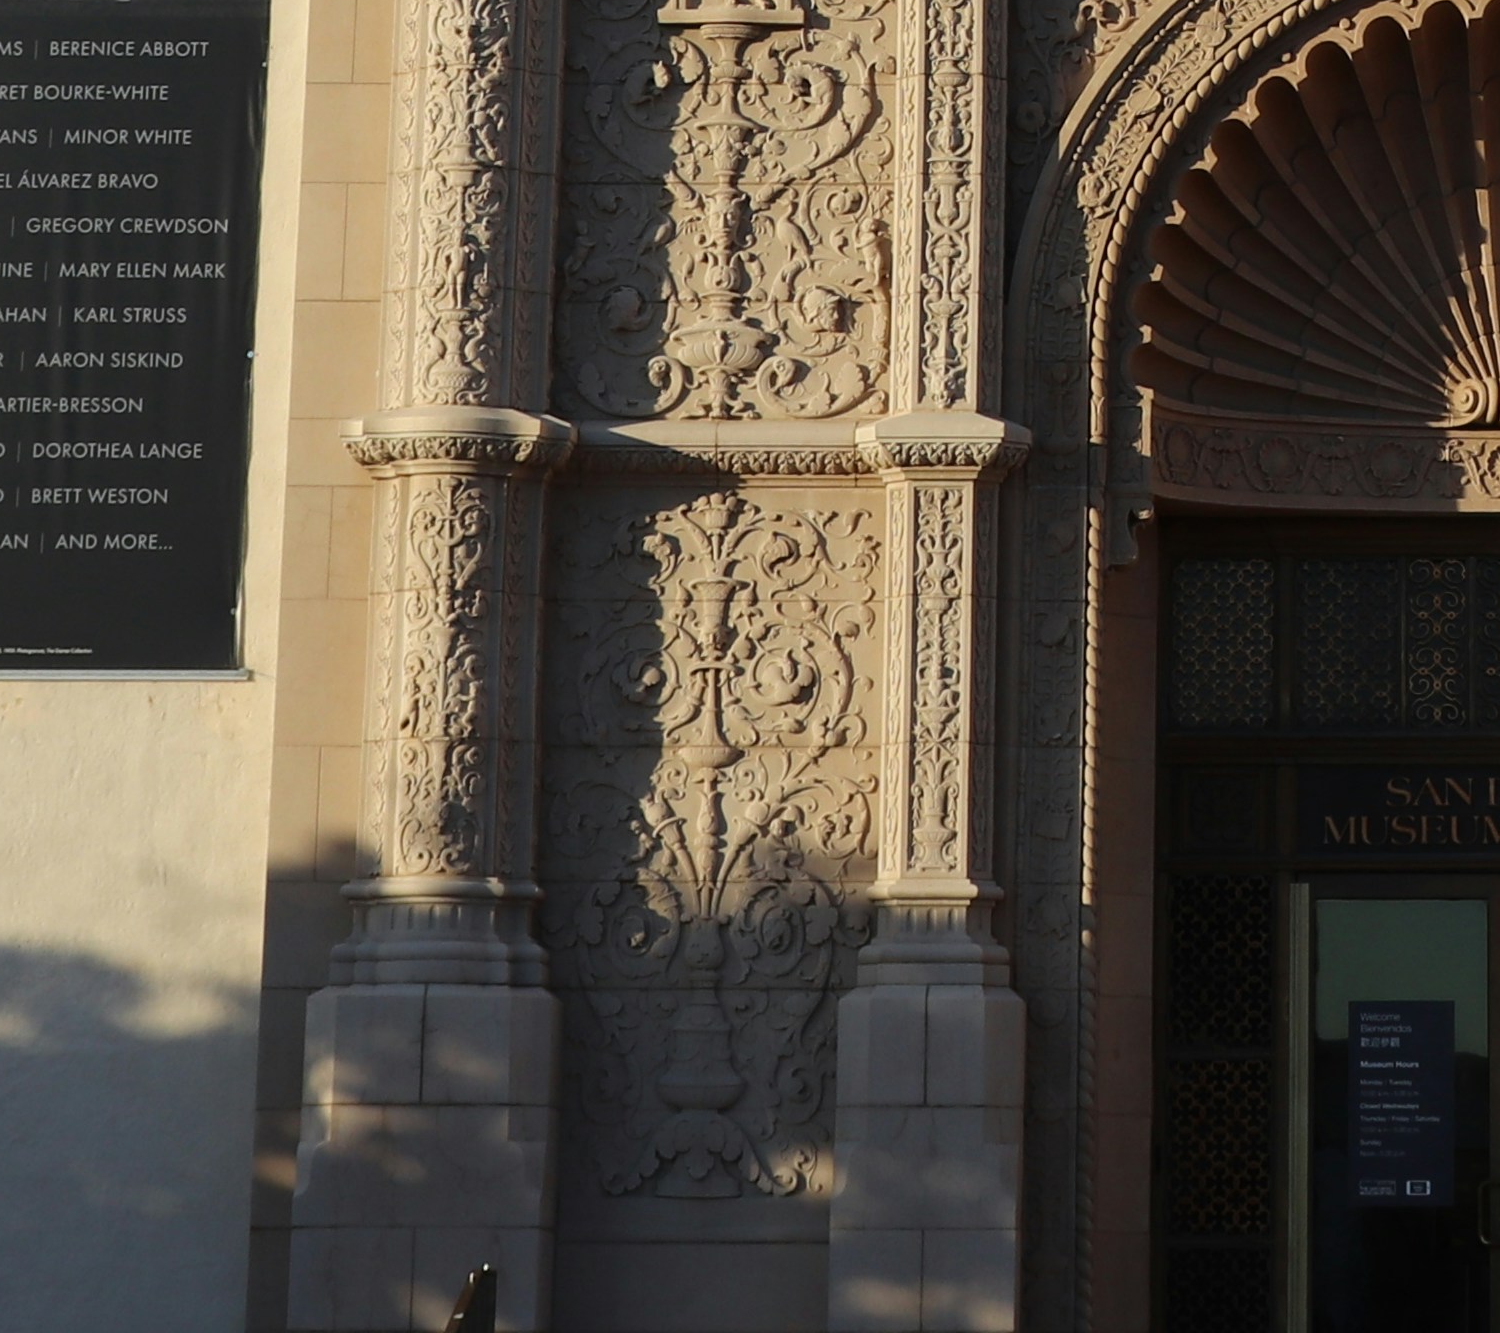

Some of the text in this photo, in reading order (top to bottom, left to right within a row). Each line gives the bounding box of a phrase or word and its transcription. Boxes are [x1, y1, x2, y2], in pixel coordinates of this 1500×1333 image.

[50, 41, 134, 56] BERENICE
[140, 41, 209, 57] ABBOTT
[34, 85, 169, 100] BOURKE-WHITE
[64, 129, 128, 144] MINOR
[135, 129, 192, 144] WHITE
[17, 169, 92, 188] ÁLVAREZ
[98, 174, 158, 188] BRAVO
[26, 218, 114, 233] GREGORY
[121, 218, 229, 233] CREWDSON
[59, 263, 110, 278] MARY
[117, 263, 166, 278] ELLEN
[173, 263, 226, 278] MARK
[73, 308, 117, 323] KARL
[122, 307, 187, 323] STRUSS
[35, 352, 103, 367] AARON
[110, 352, 183, 367] SISKIND
[32, 443, 133, 458] DOROTHEA
[140, 443, 203, 458] LANGE
[31, 488, 82, 503] BRETT
[88, 488, 168, 504] WESTON
[55, 534, 98, 549] AND
[104, 534, 173, 549] MORE...
[1386, 776, 1473, 807] SAN
[1395, 1060, 1419, 1068] Hours
